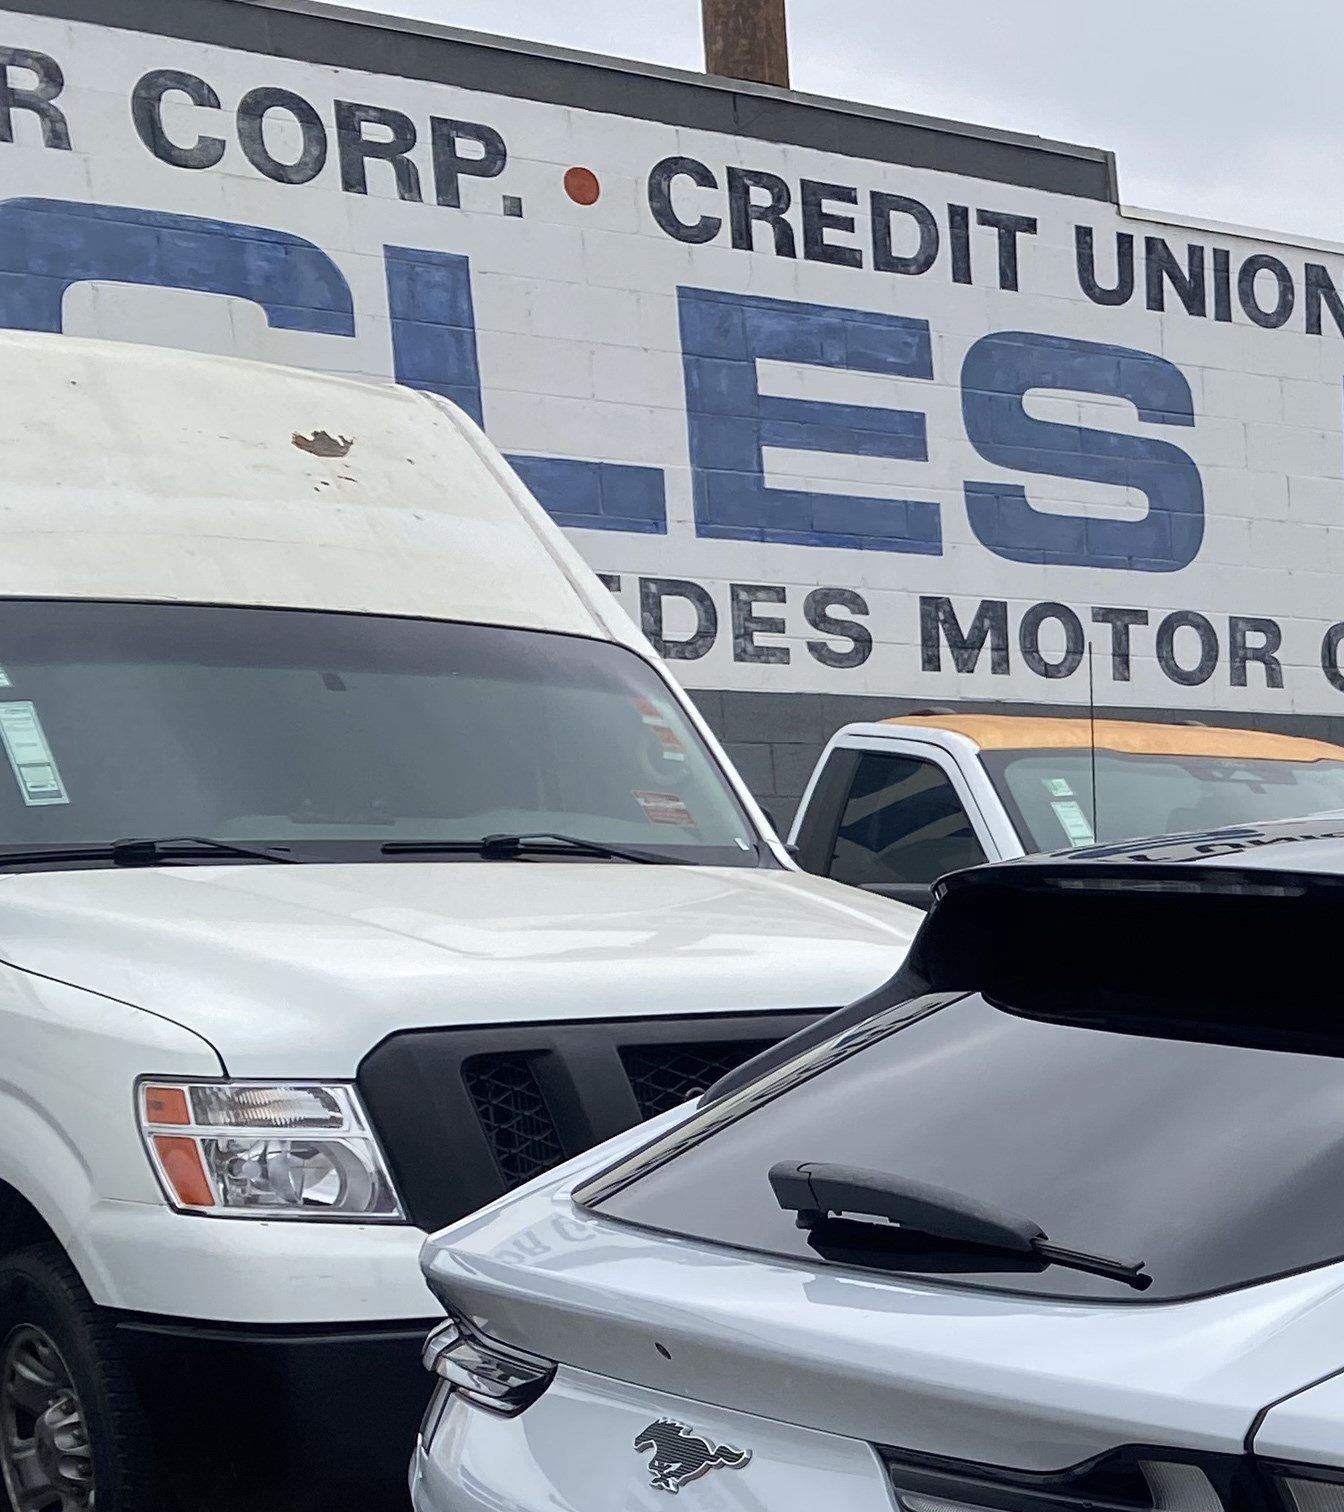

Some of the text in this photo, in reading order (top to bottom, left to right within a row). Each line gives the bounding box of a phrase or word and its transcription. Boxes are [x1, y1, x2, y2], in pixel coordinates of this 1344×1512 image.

[131, 69, 523, 218] CORP.
[647, 155, 1037, 292] CREDIT
[596, 572, 873, 669] DES
[918, 595, 1285, 690] MOTOR
